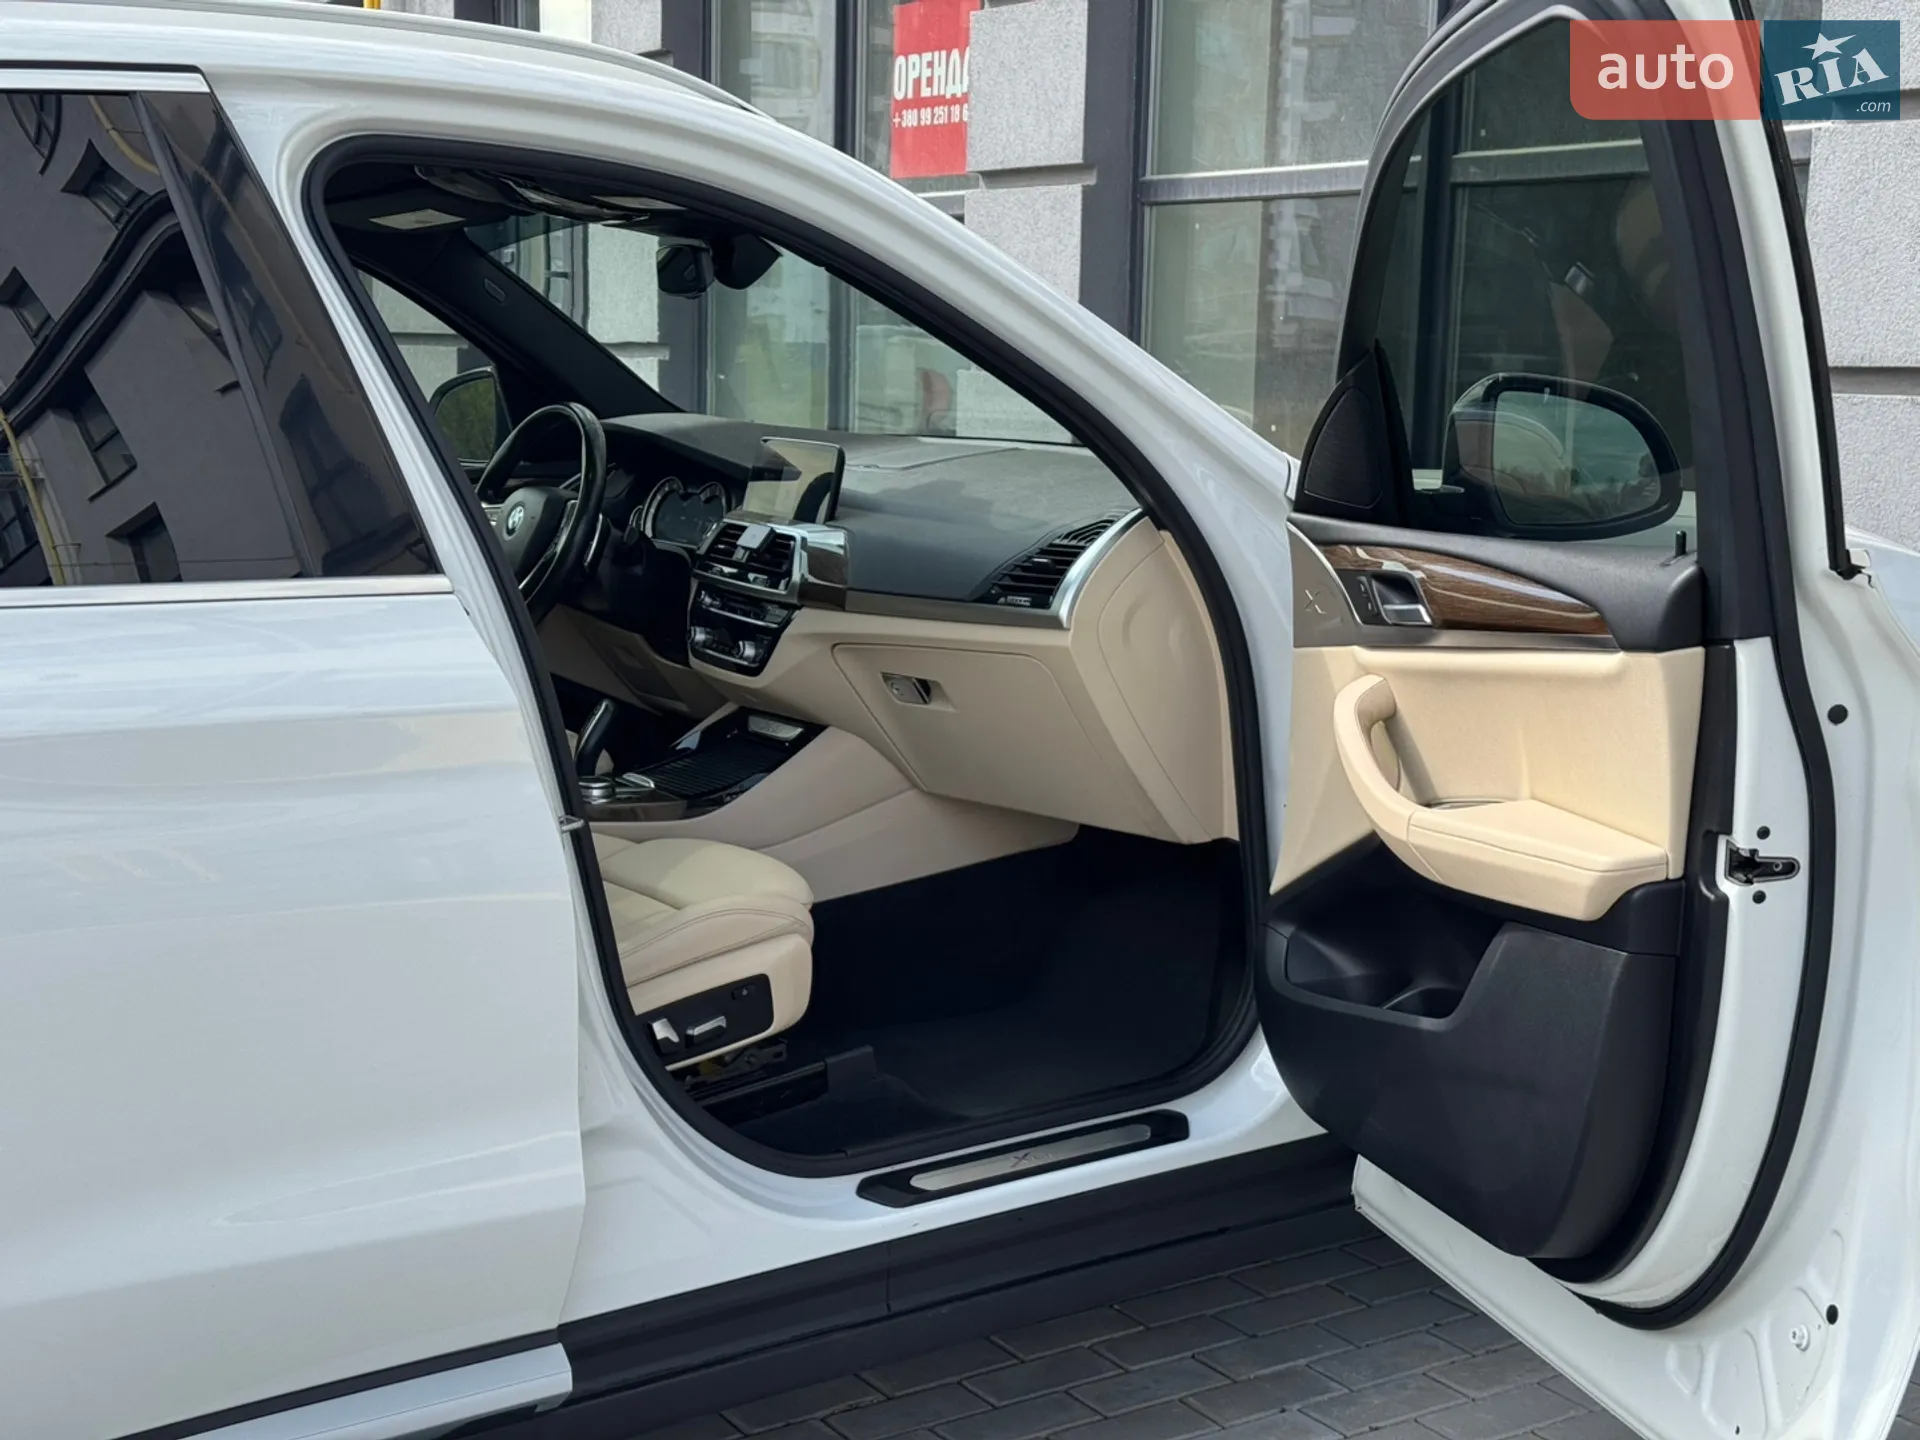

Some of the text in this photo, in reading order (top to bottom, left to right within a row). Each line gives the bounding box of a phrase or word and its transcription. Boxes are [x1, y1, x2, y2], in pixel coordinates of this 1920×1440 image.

[893, 108, 919, 128] +380
[920, 106, 932, 126] 99
[933, 104, 948, 125] 251
[950, 103, 961, 123] 18
